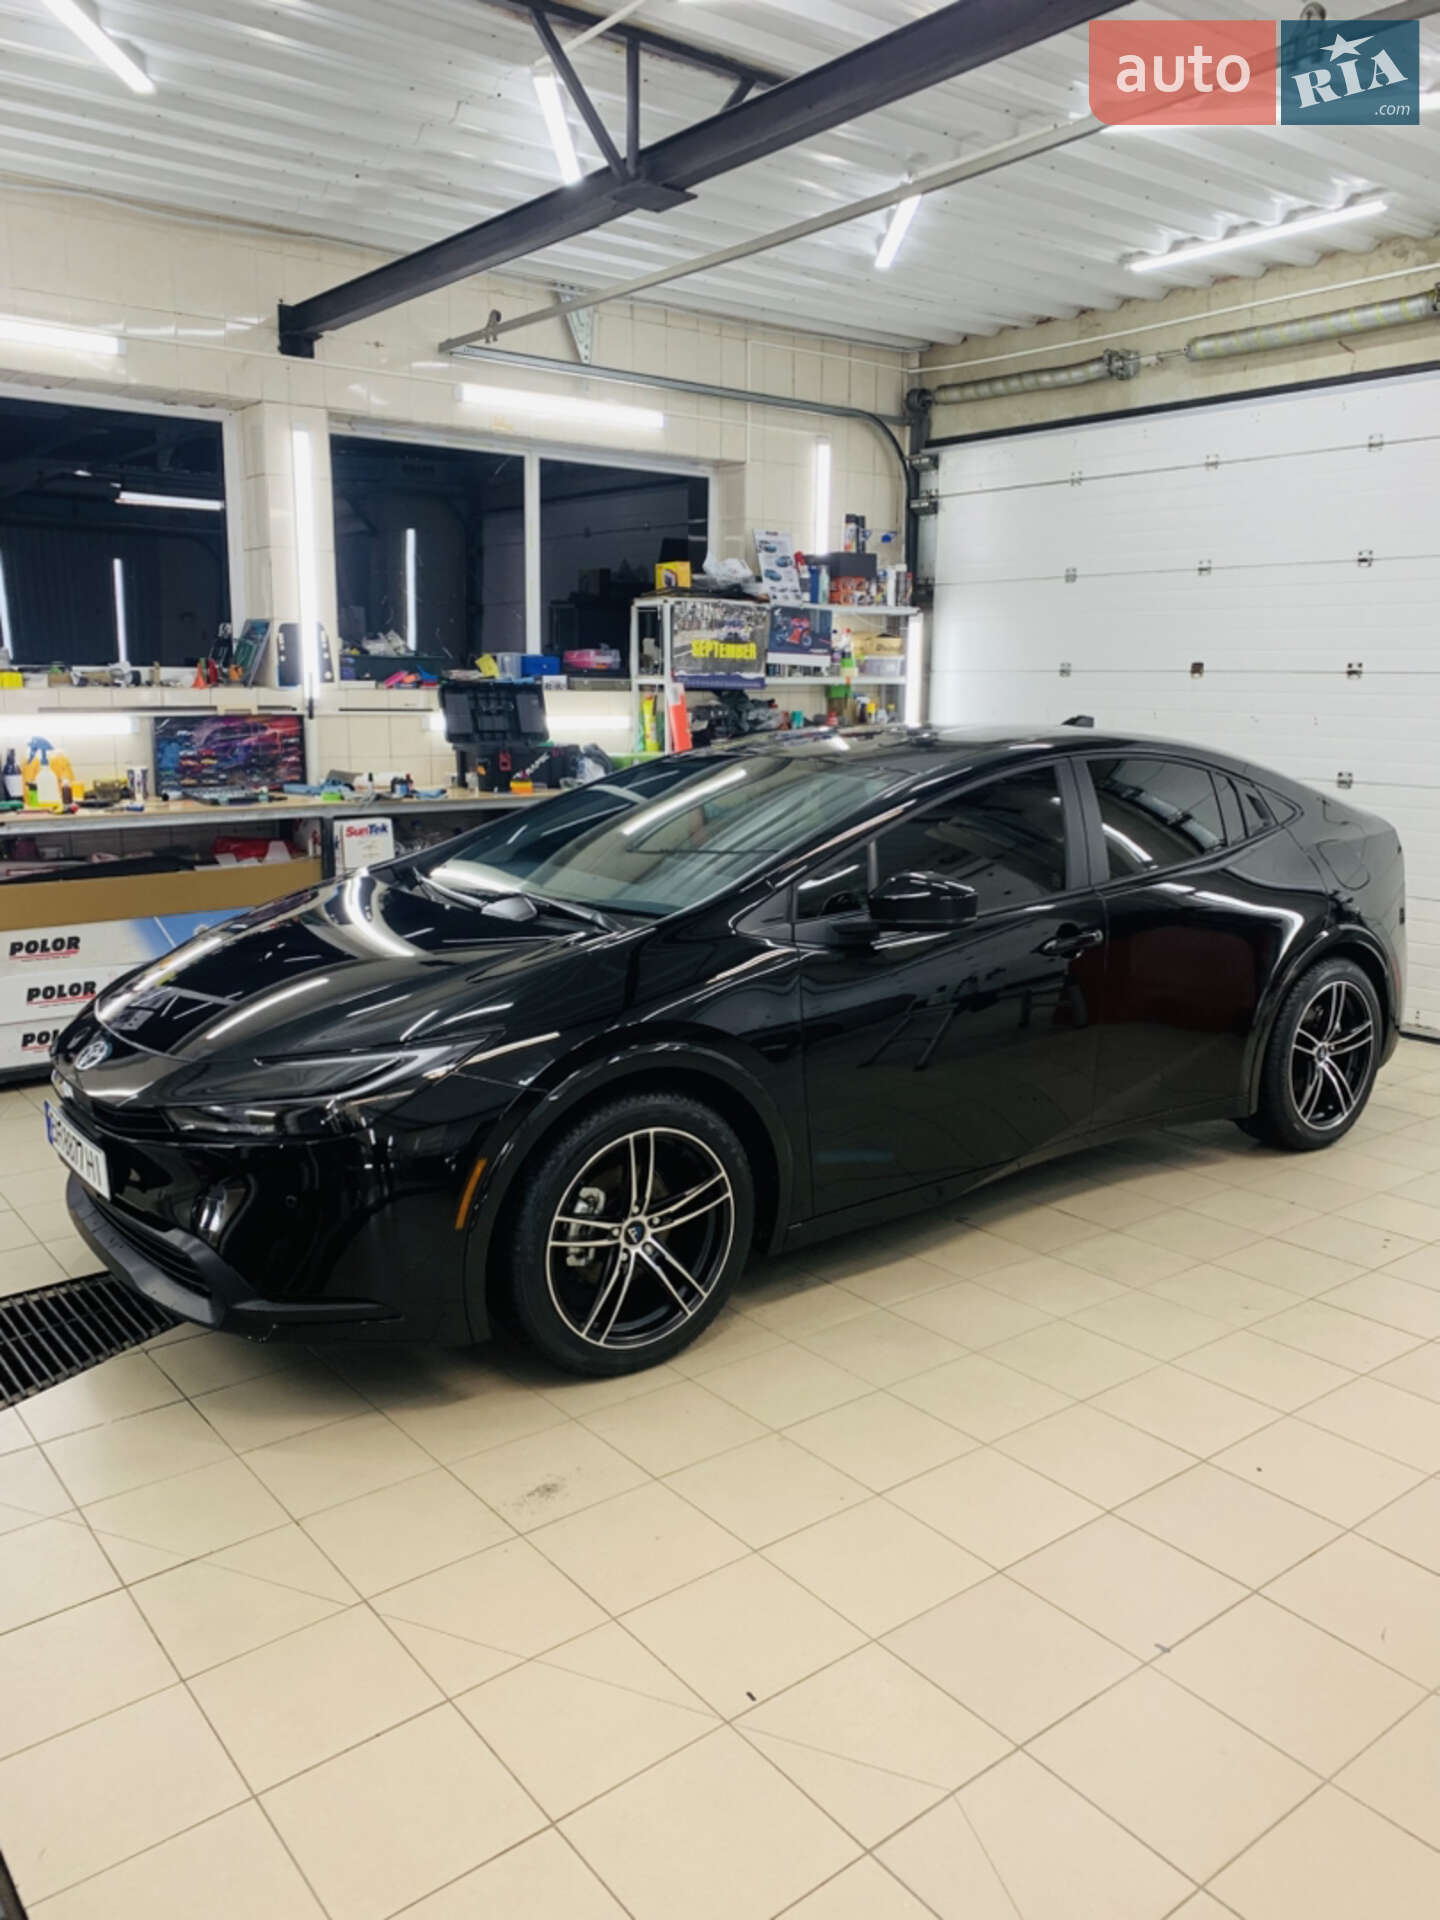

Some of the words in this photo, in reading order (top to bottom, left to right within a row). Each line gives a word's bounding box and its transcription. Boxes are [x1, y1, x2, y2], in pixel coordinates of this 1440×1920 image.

[691, 639, 757, 660] SEPTEMBER
[346, 823, 388, 838] SunTek
[9, 936, 81, 956] POLOR
[26, 981, 97, 1002] POLOR
